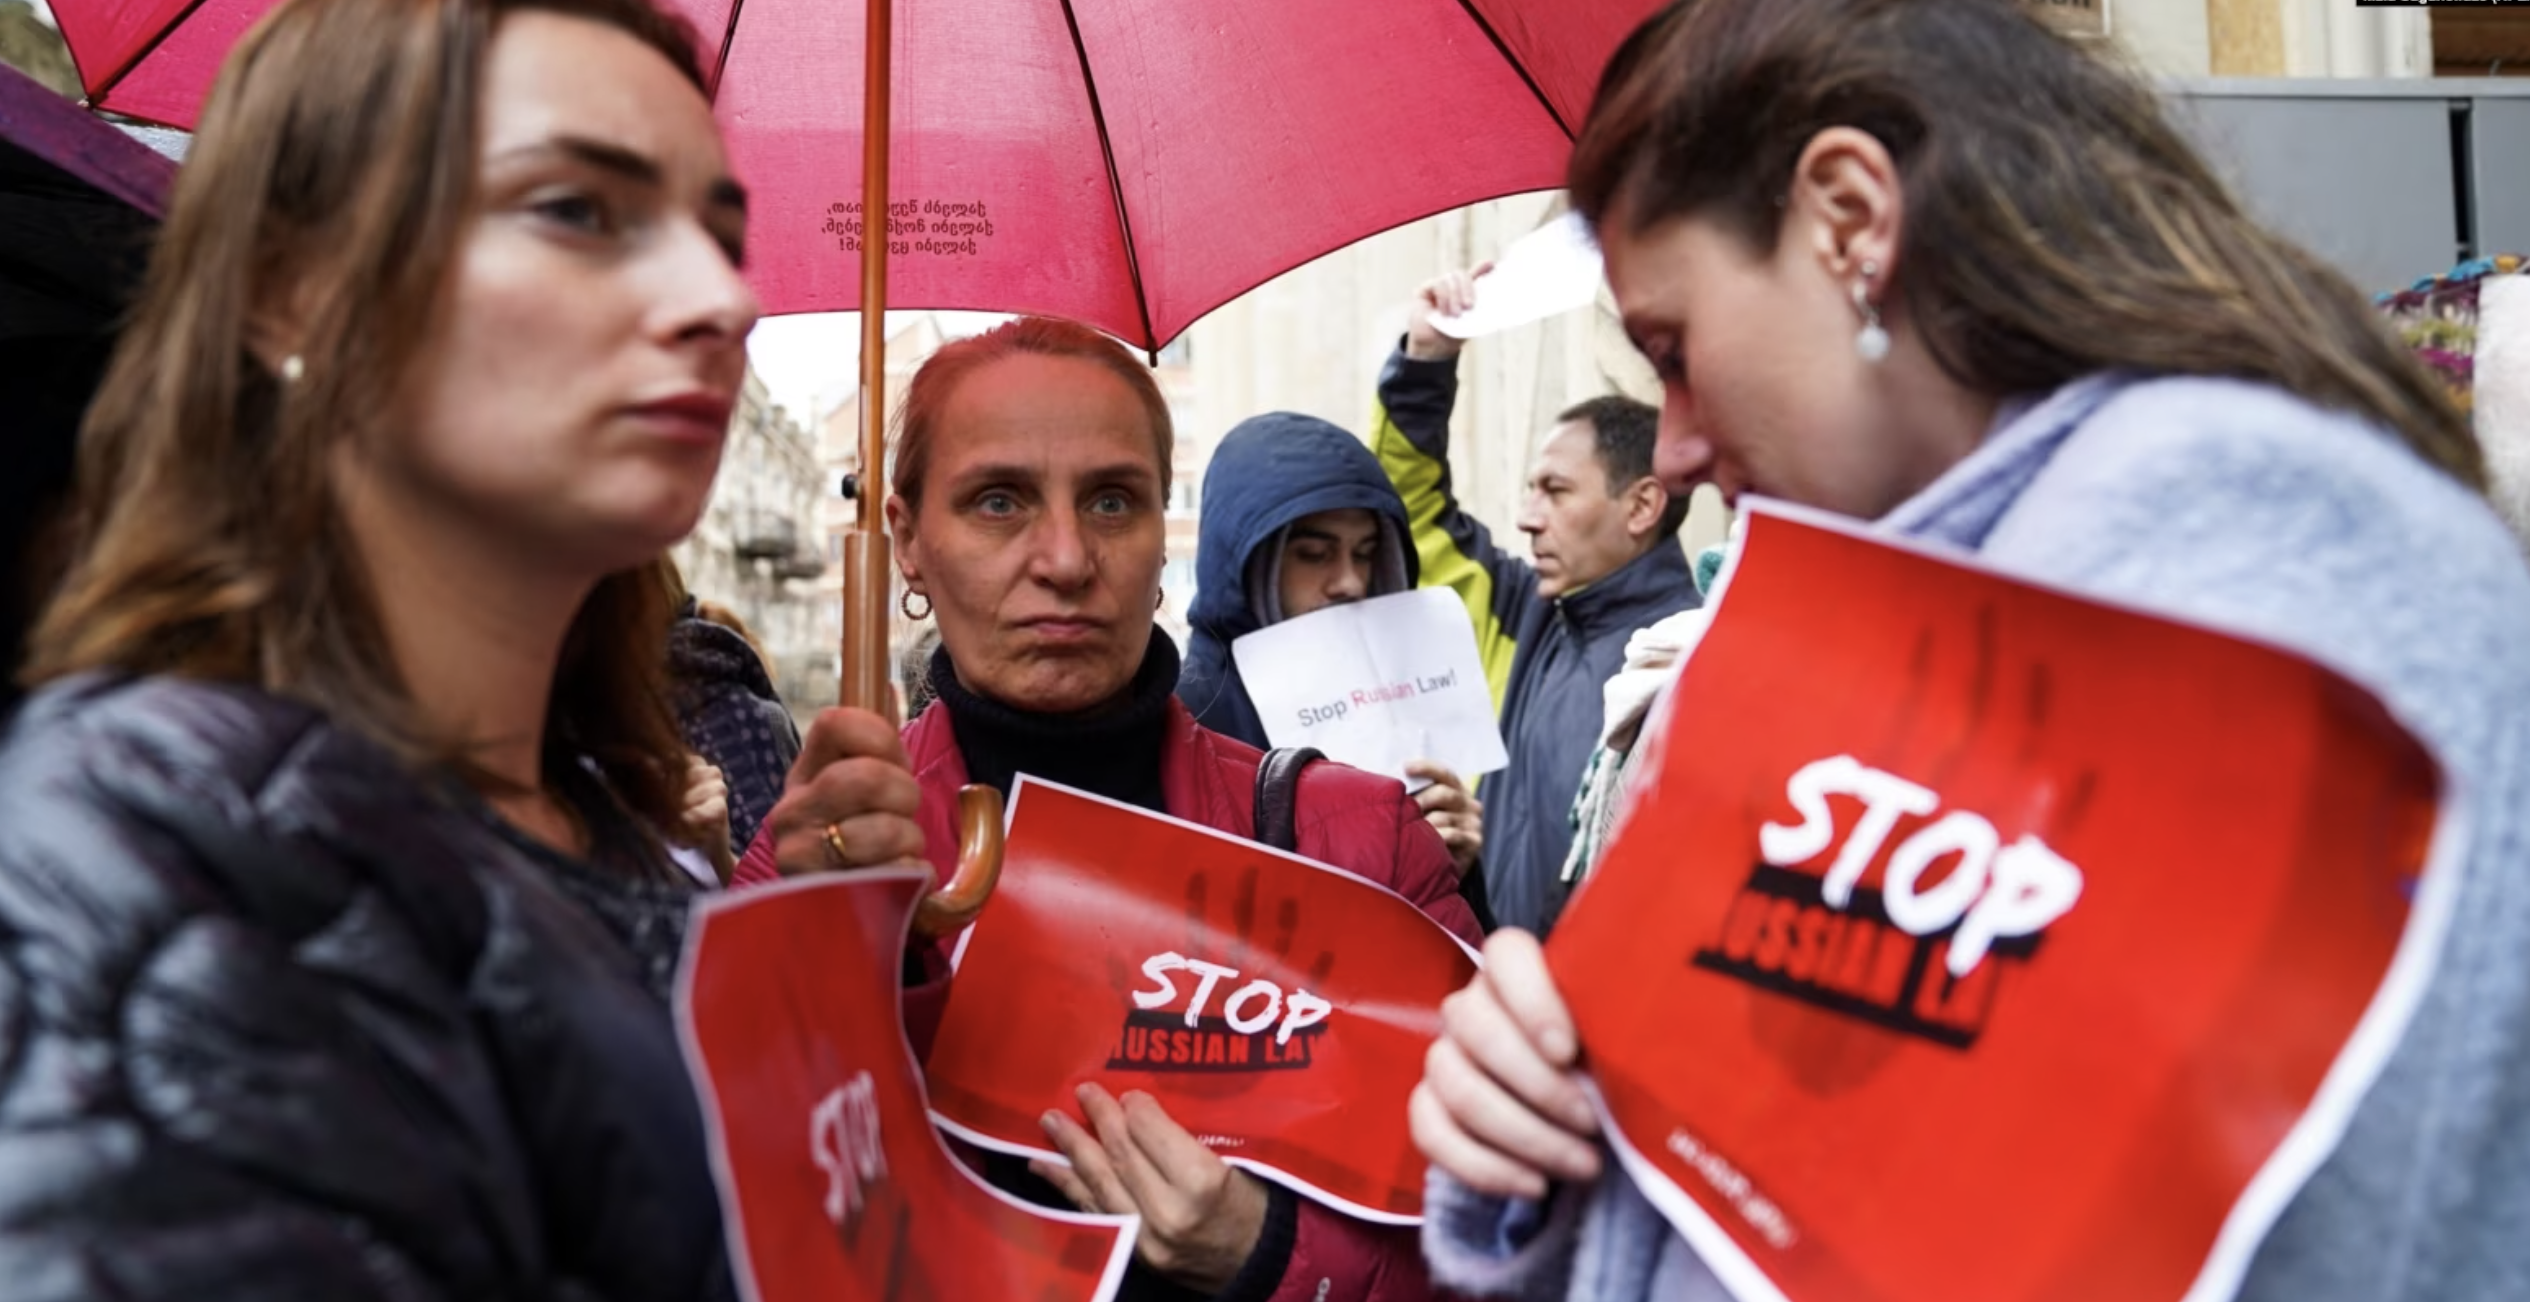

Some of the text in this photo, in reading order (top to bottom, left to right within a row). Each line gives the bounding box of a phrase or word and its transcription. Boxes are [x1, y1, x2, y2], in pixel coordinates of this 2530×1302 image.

[1298, 700, 1347, 727] Stop
[1416, 668, 1457, 694] Law!
[1759, 754, 2084, 977] STOP
[1132, 951, 1332, 1045] STOP
